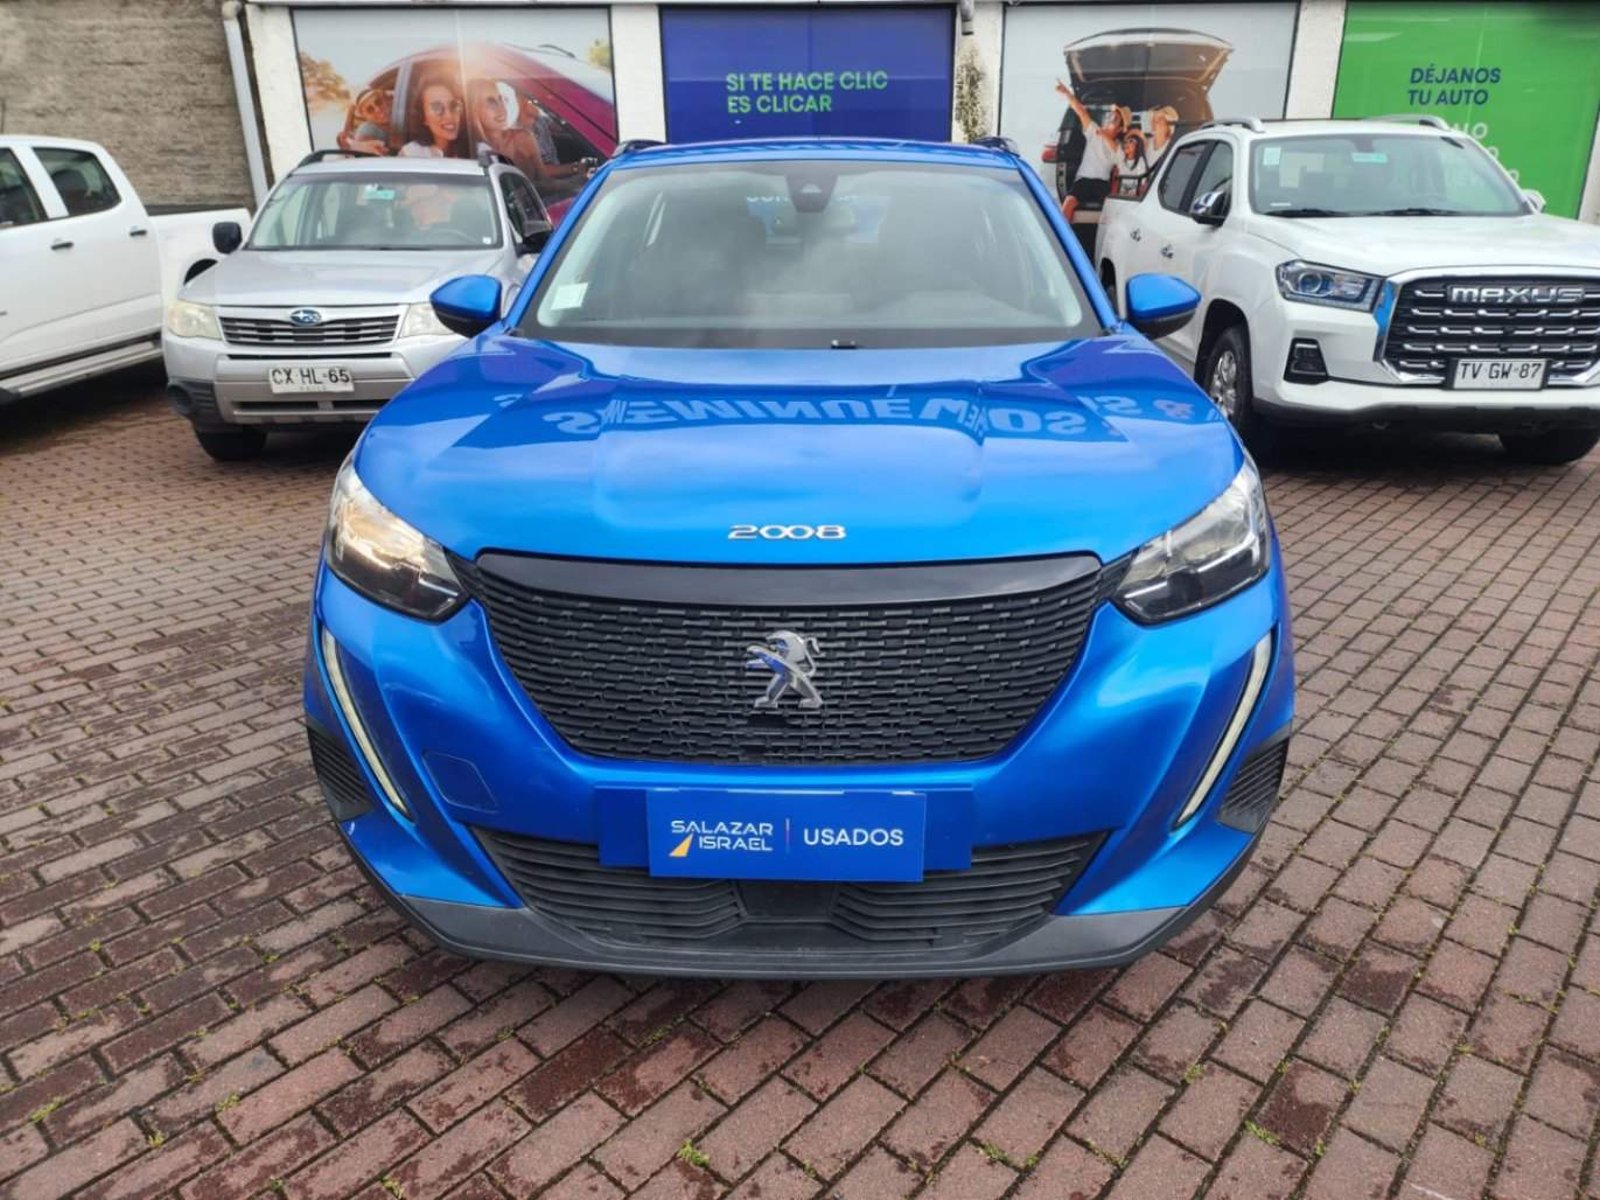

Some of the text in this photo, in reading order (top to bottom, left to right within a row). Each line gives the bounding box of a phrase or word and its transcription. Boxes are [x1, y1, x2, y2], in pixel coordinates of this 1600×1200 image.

[726, 70, 888, 91] SI TE HACE CLIC
[1410, 63, 1502, 84] DÉJANOS
[727, 94, 832, 113] ES CLICAR
[1408, 89, 1489, 106] TU AUTO
[1451, 286, 1583, 303] MAXUS
[271, 368, 294, 384] CX
[1460, 363, 1482, 379] TV
[727, 524, 847, 540] 2008
[671, 820, 774, 836] SALAZAR
[699, 836, 773, 851] ISRAEL
[803, 828, 905, 846] USADOS
